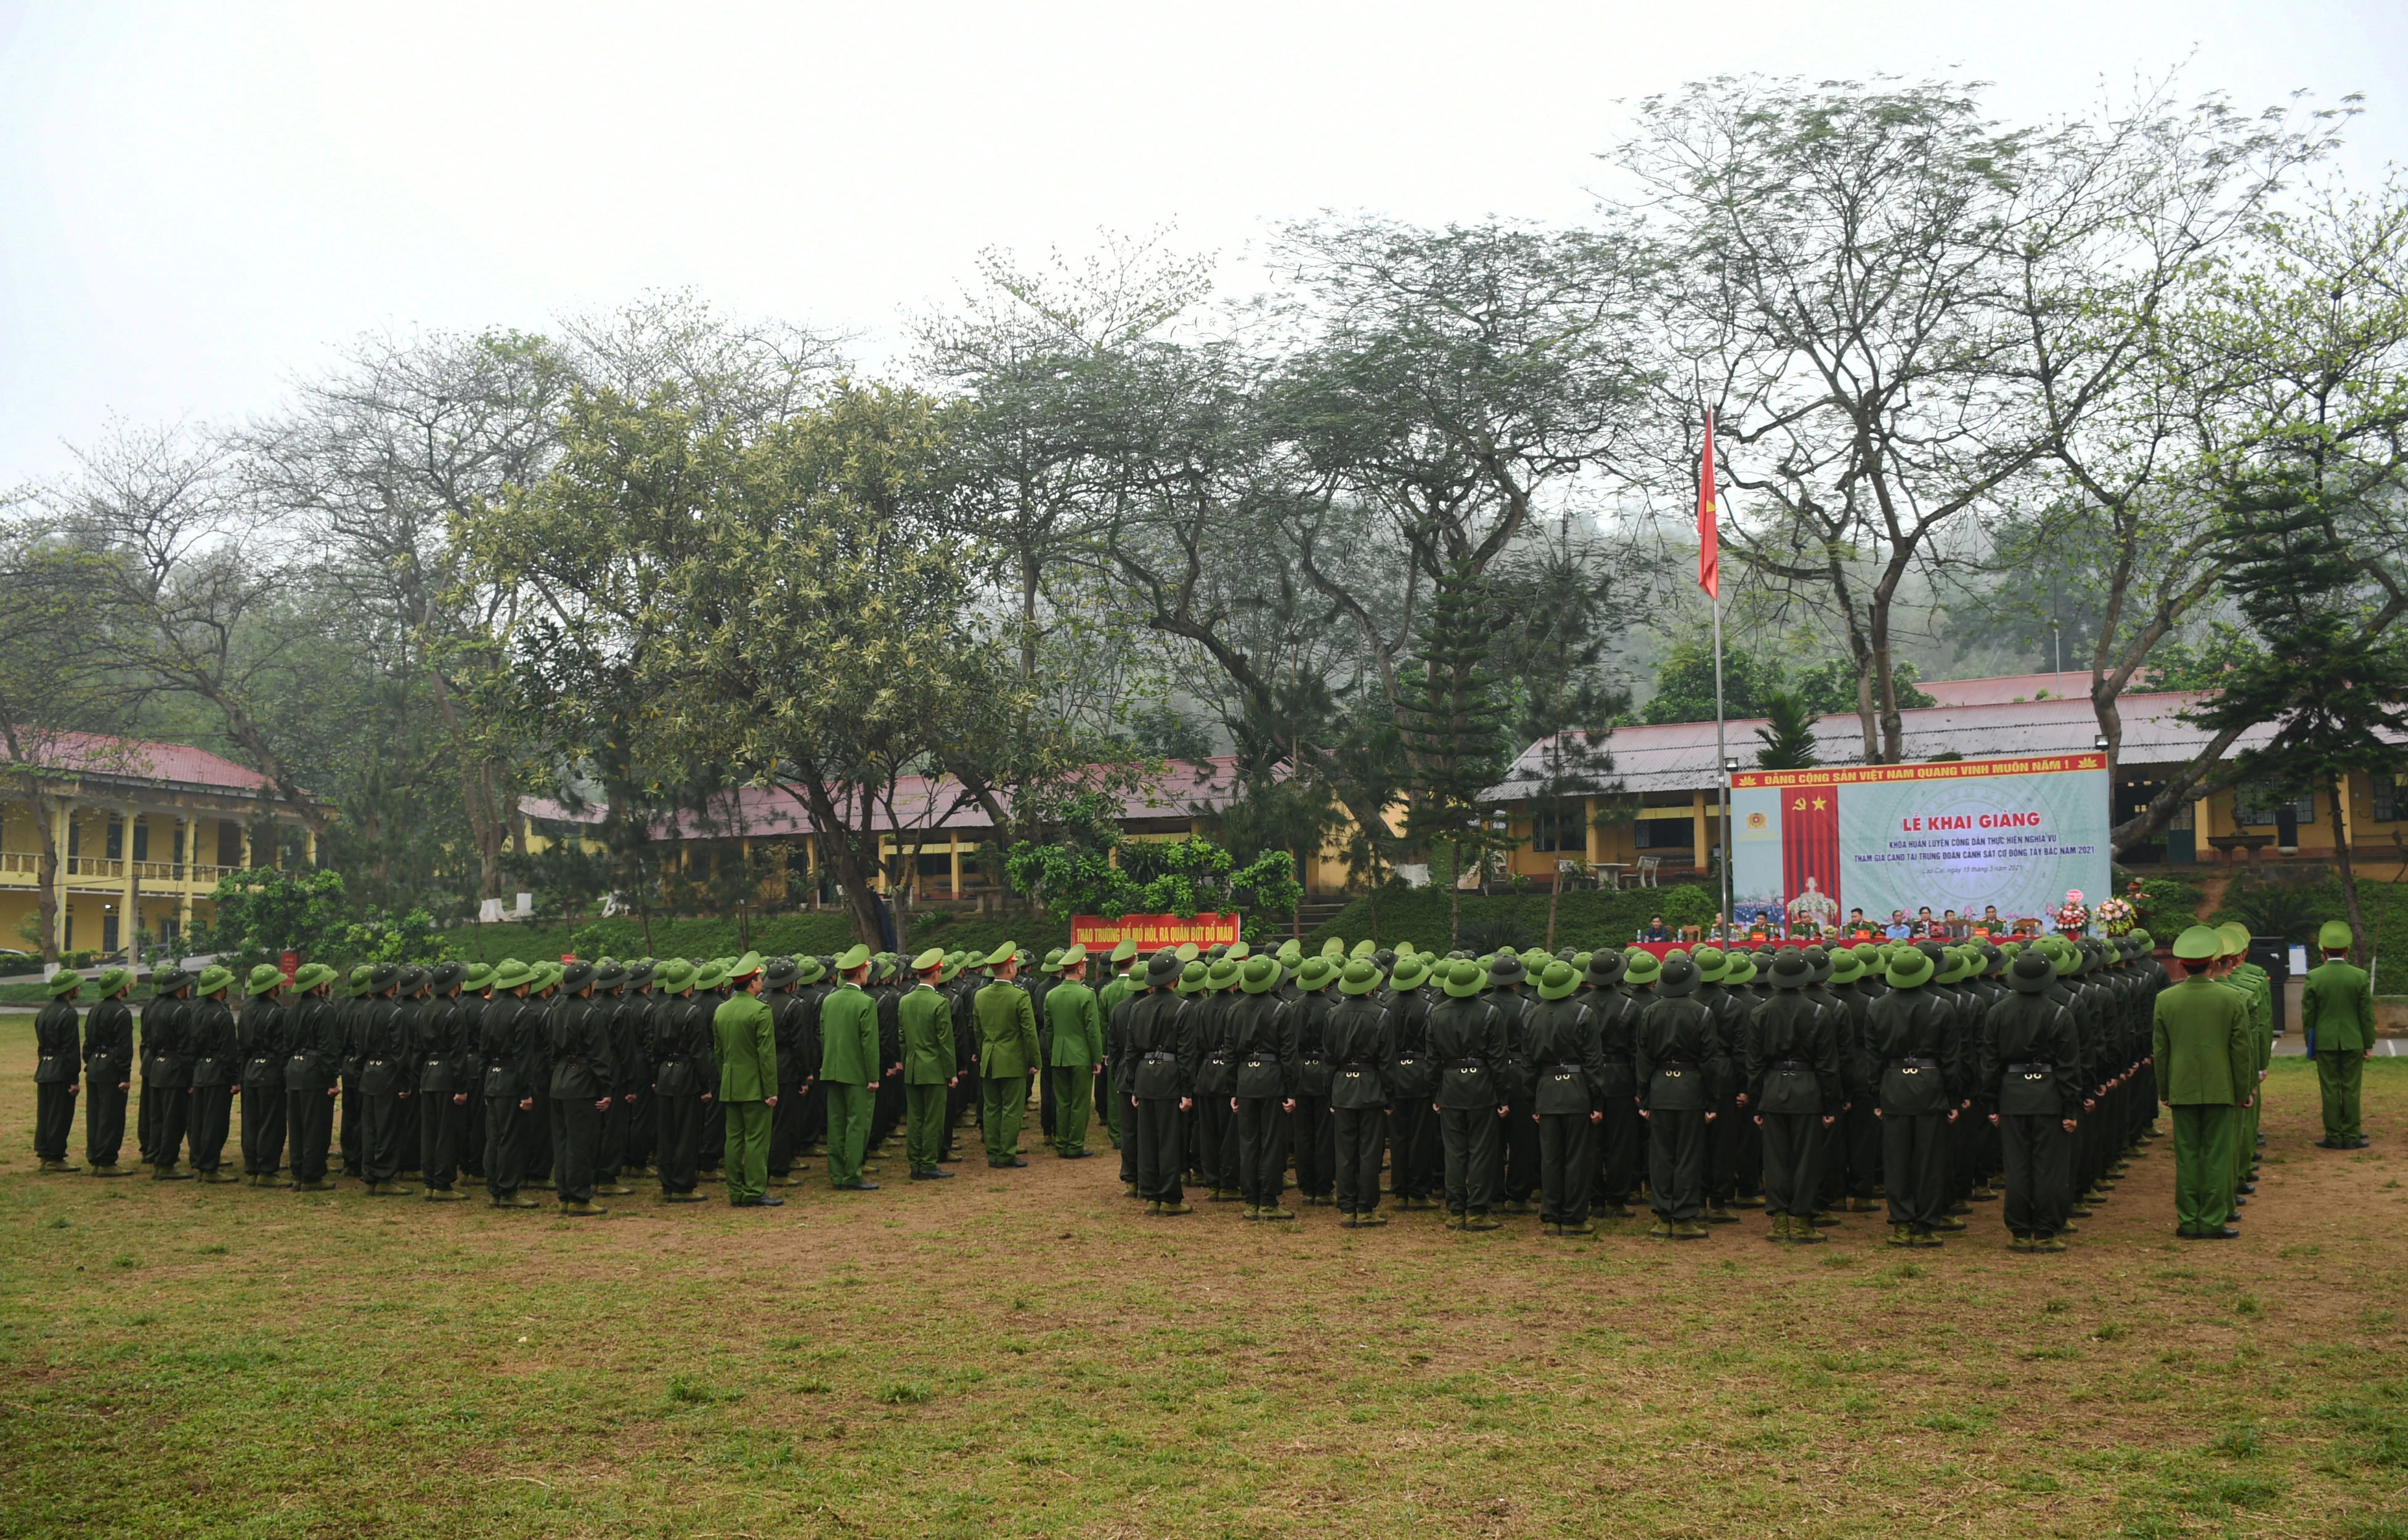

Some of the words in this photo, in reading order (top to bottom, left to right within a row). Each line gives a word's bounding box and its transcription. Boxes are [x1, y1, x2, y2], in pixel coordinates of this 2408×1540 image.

[1765, 772, 1796, 785] ĐẢNG
[1798, 772, 1829, 784] CỘNG
[1832, 769, 1857, 782] SẢN
[1860, 770, 1884, 782] VIỆT
[1887, 769, 1914, 779] NAM
[1918, 767, 1958, 777] QUANG
[1961, 766, 1989, 776] VINH
[1992, 761, 2029, 773] MUÔN
[2032, 759, 2061, 771] NĂM
[2065, 760, 2069, 769] !
[1902, 812, 1921, 832] LỄ
[1928, 816, 1972, 830] KHAI
[1979, 809, 2041, 829] GIẢNG
[1951, 837, 1970, 846] CÔNG
[1972, 836, 1985, 846] DÂN
[1988, 836, 2004, 846] THỰC
[1854, 853, 1873, 862] THAM
[1874, 853, 1885, 862] GIA
[1887, 853, 1905, 862] CAND
[1919, 852, 1940, 861] TRUNG
[1963, 848, 1982, 859] CẢNH
[1983, 848, 1996, 858] SÁT
[1998, 849, 2007, 857] CƠ
[2078, 846, 2095, 854] 2021
[1076, 928, 1093, 942] THAO
[1094, 924, 1120, 943] TRƯỜNG
[1159, 926, 1169, 942] RA
[1171, 923, 1189, 943] QUÂN
[1190, 922, 1204, 942] BỚT
[1205, 920, 1215, 941] ĐỔ
[1216, 922, 1233, 941] MÁU
